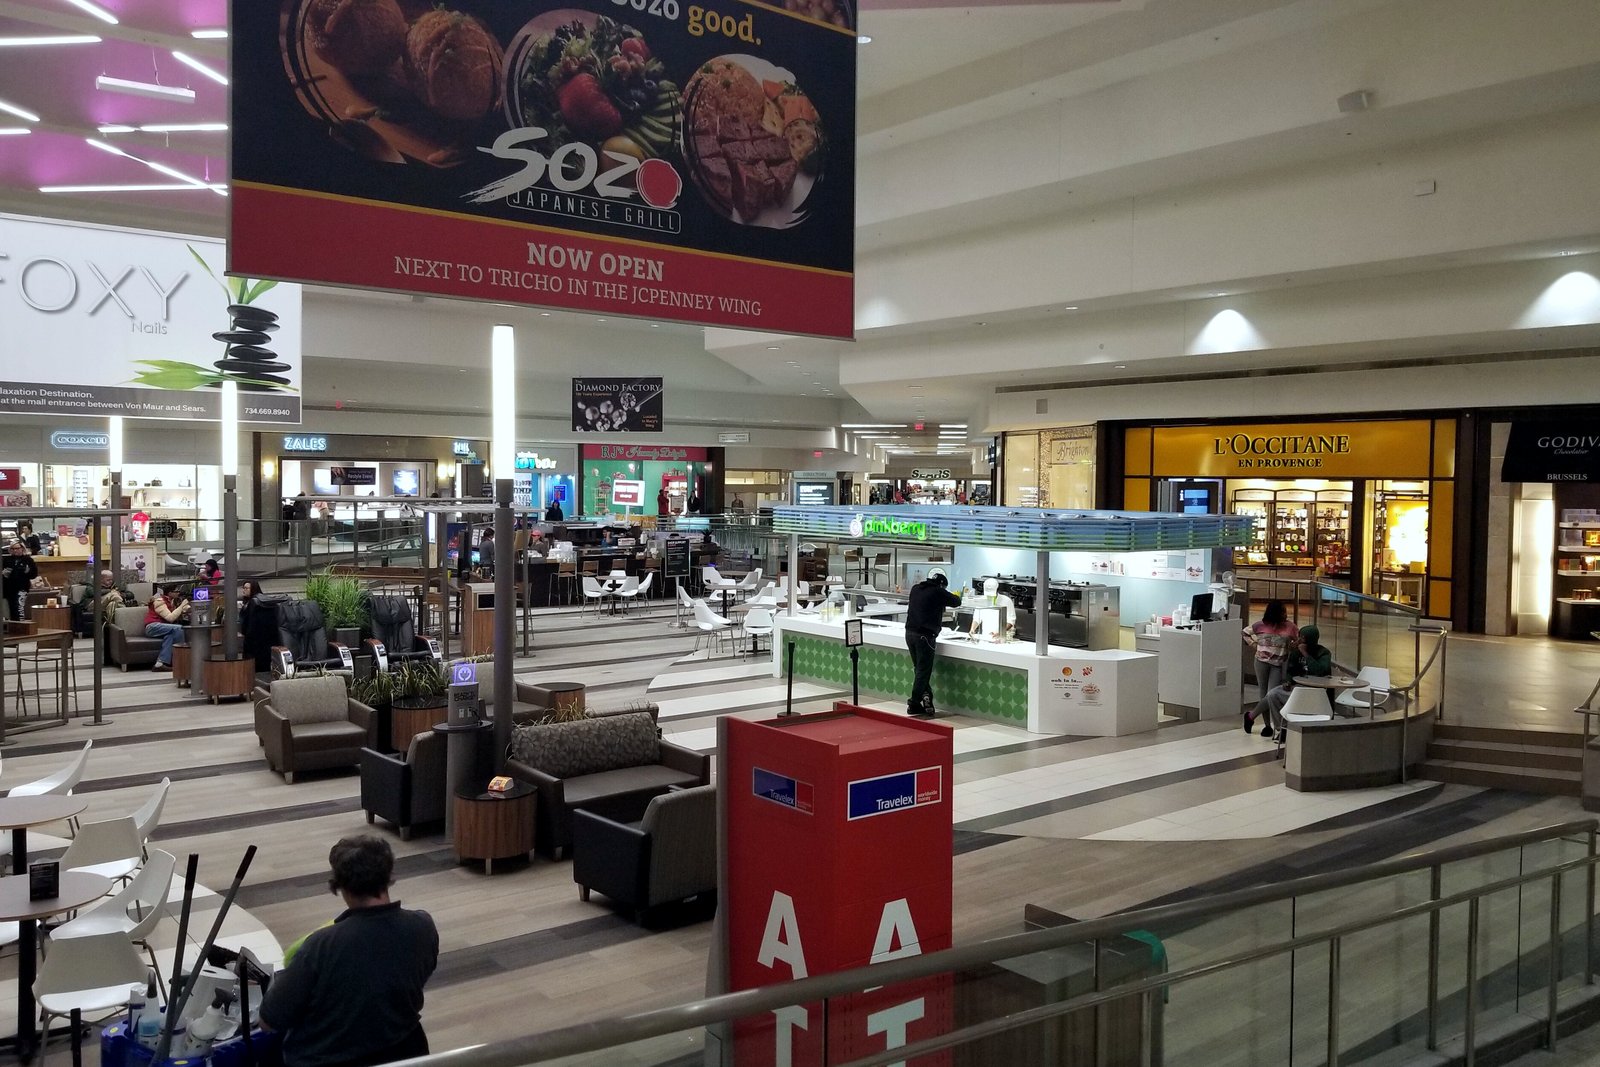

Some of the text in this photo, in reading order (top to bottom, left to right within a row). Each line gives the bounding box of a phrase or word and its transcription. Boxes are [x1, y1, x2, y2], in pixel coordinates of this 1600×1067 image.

[612, 0, 761, 45] ozo good.
[511, 190, 675, 230] JAPANESE GRILL
[527, 242, 664, 282] NOW OPEN
[394, 256, 762, 316] NEXT TO TRICHO IN THE JCPENNEY WING
[131, 321, 168, 335] Nails
[40, 389, 95, 399] Destination.
[575, 383, 662, 392] DIAMOND FACTORY
[48, 400, 86, 408] entrance
[87, 401, 123, 409] between
[125, 402, 141, 410] Von
[143, 403, 164, 411] Maur
[182, 405, 206, 413] Sears.
[244, 407, 291, 416] 734.669.8940
[57, 436, 107, 445] COACH
[284, 436, 327, 450] ZALES
[1214, 433, 1351, 456] L'OCCITANE
[1537, 436, 1600, 448] GODIV
[1238, 458, 1323, 468] EN PROVENCE
[1547, 473, 1588, 481] BRUSSELS
[864, 515, 928, 541] pinkberry
[769, 788, 795, 805] Travelex
[876, 794, 914, 811] Travelex
